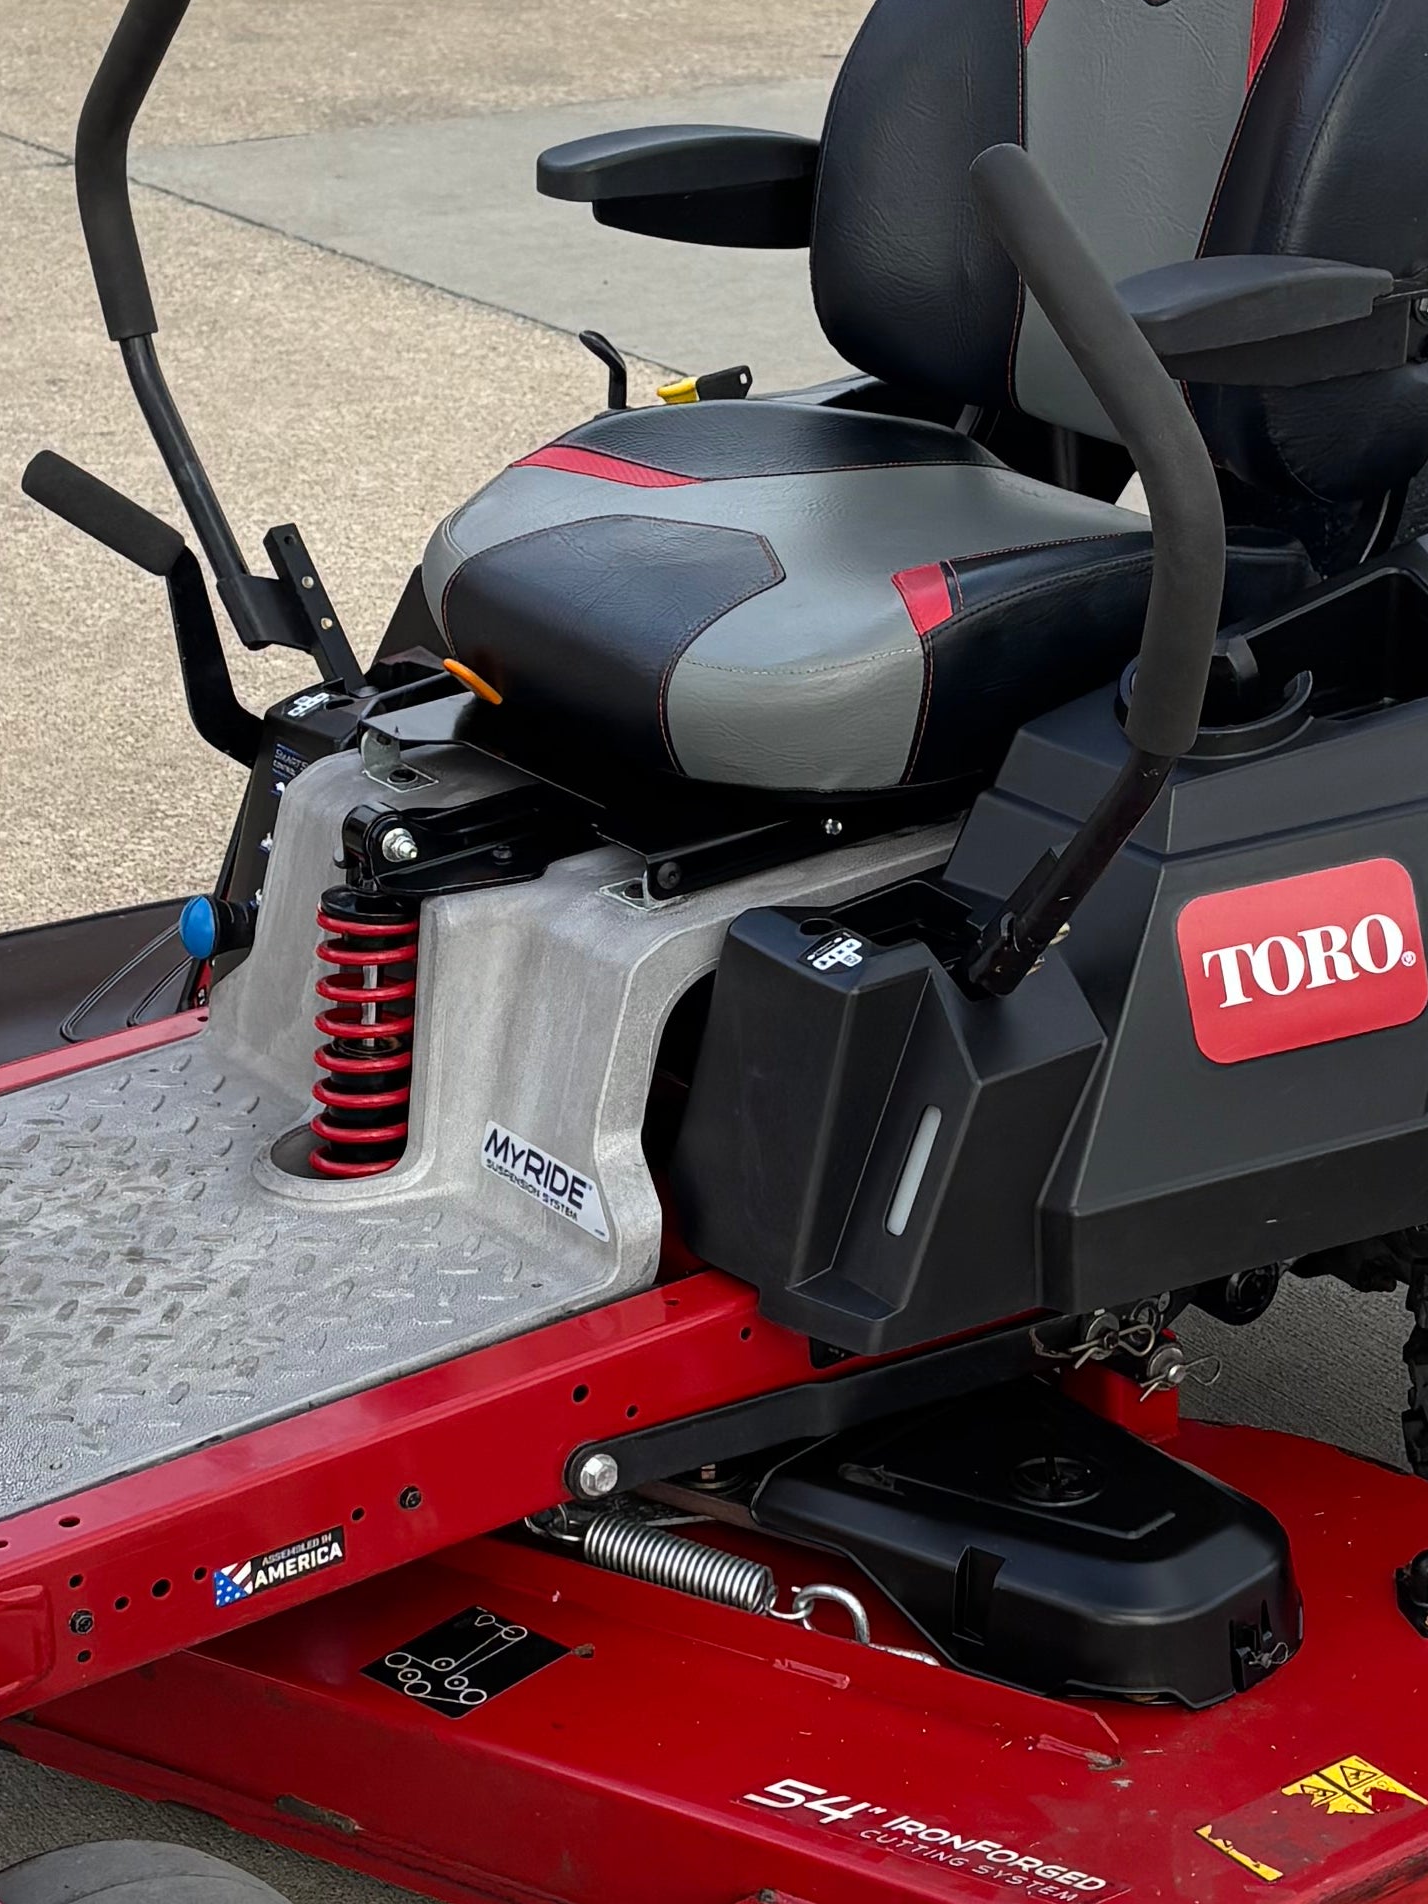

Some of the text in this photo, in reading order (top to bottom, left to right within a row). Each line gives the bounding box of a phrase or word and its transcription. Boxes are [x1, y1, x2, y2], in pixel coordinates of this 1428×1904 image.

[486, 1158, 579, 1222] SUSPENSION SYSTEM
[254, 1542, 343, 1589] AMERICA
[262, 1532, 332, 1567] ASSEMBLED IN
[743, 1778, 1107, 1891] 54" IRONFORGED
[860, 1829, 1079, 1902] CUTTING SYSTEM
